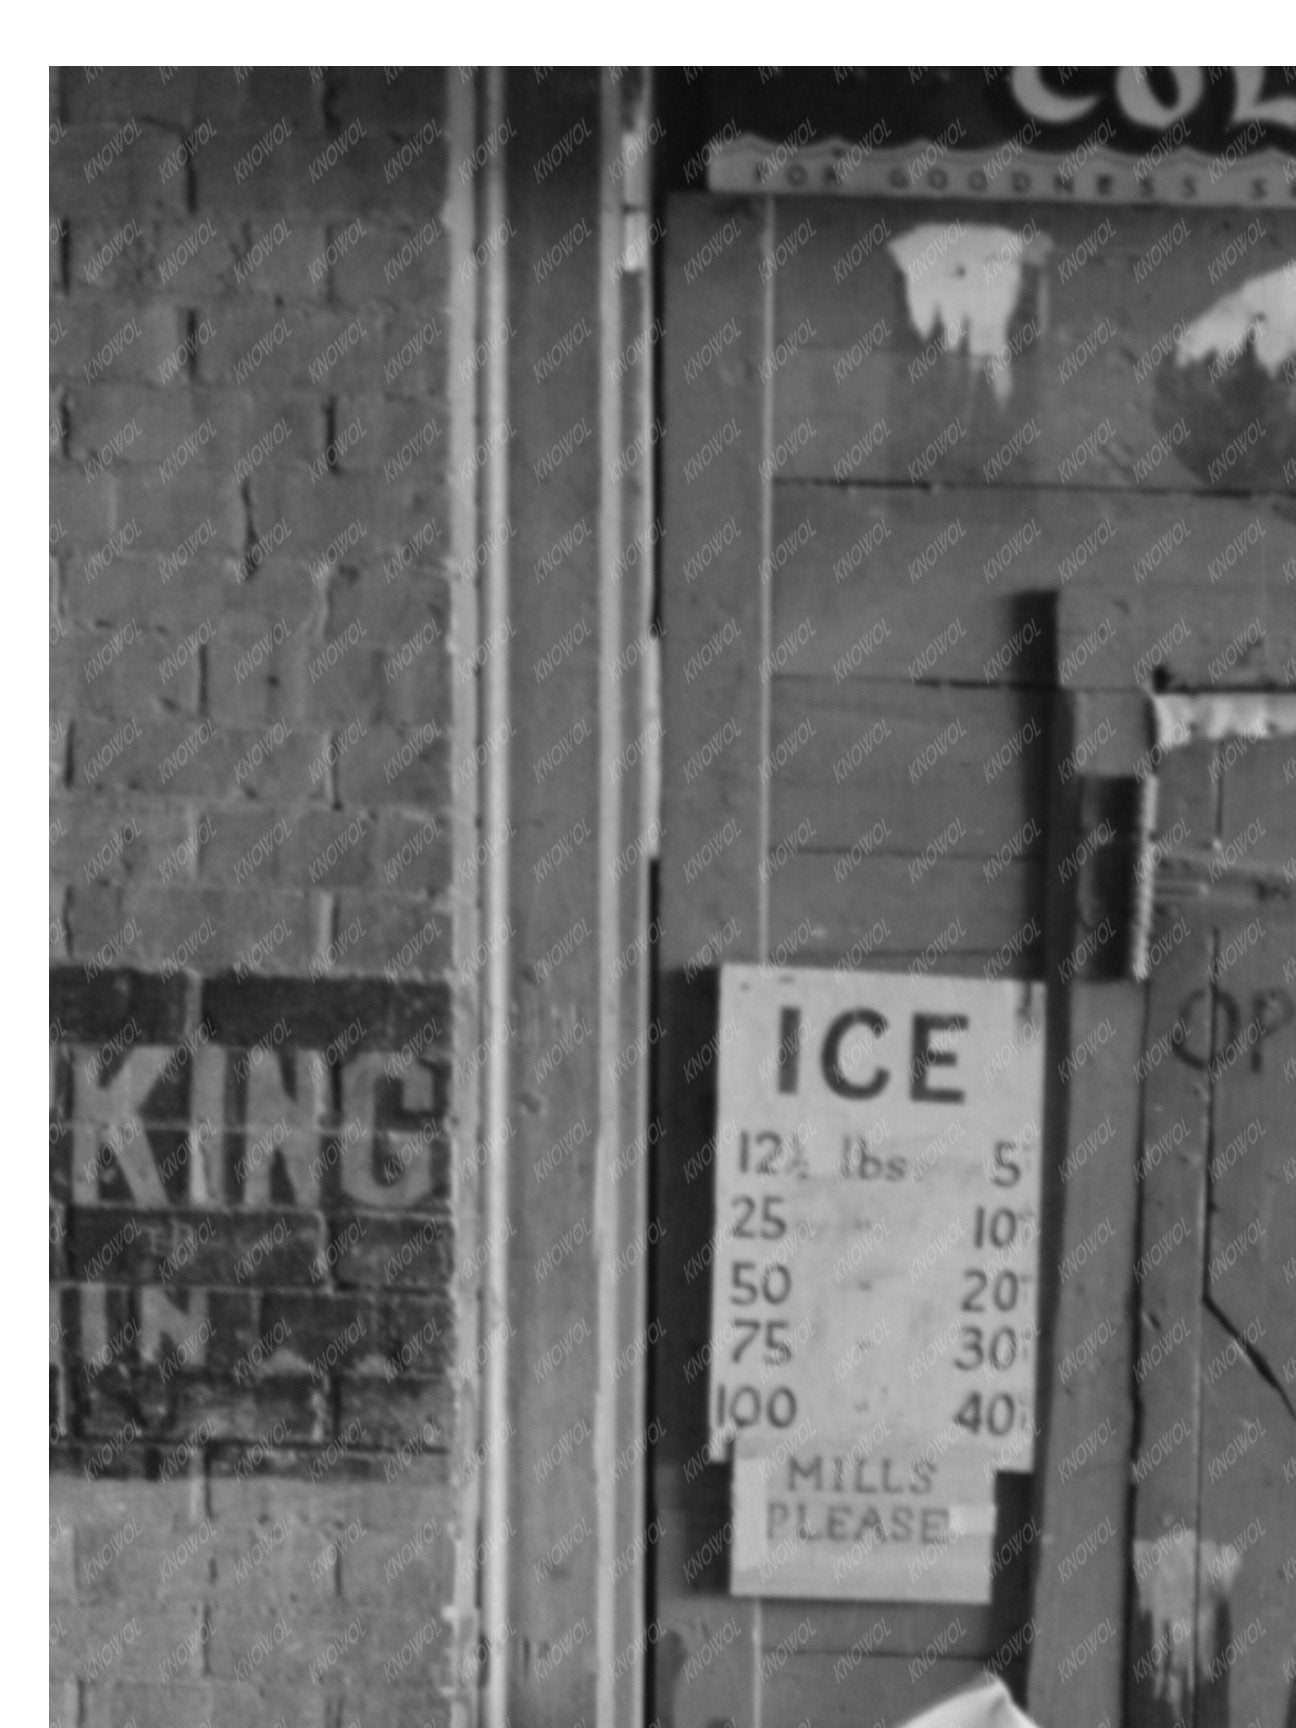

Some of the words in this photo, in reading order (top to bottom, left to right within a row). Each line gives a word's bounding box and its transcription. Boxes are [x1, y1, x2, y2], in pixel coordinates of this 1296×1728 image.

[889, 168, 1198, 198] GOODNESS
[777, 1006, 970, 1104] ICE
[72, 1043, 435, 1206] KING
[730, 1195, 788, 1240] 25
[730, 1260, 792, 1306] 50
[732, 1318, 792, 1365] 75
[717, 1384, 798, 1429] 100
[785, 1455, 938, 1497] MILLS
[767, 1504, 951, 1546] PLEASE
